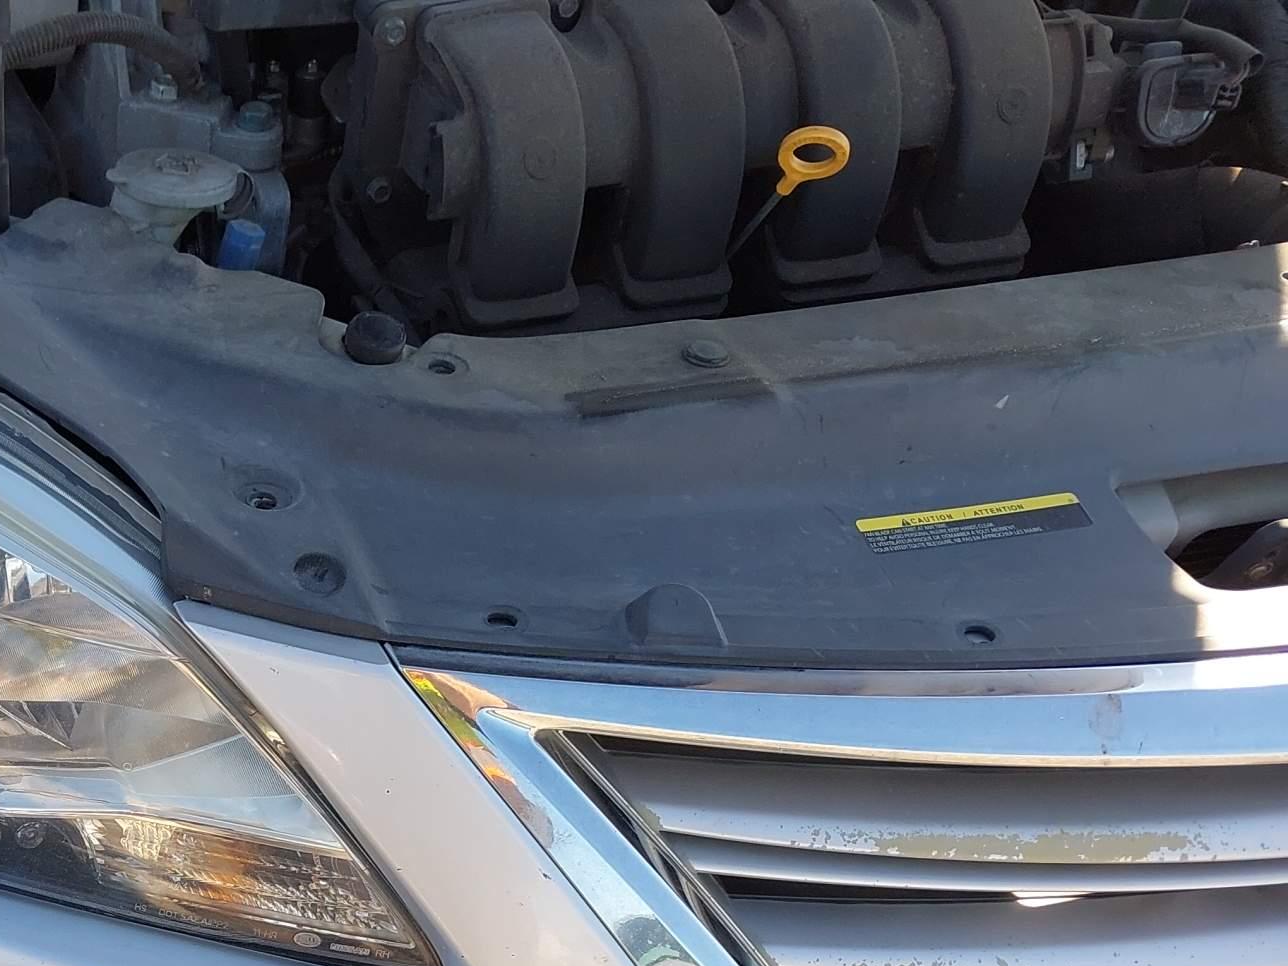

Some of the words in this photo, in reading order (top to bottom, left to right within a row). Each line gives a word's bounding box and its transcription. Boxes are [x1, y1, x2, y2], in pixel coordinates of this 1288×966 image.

[910, 513, 954, 524] CAUTION
[973, 503, 1024, 517] ATTENTION
[158, 907, 178, 919] DOT
[374, 949, 390, 959] RH
